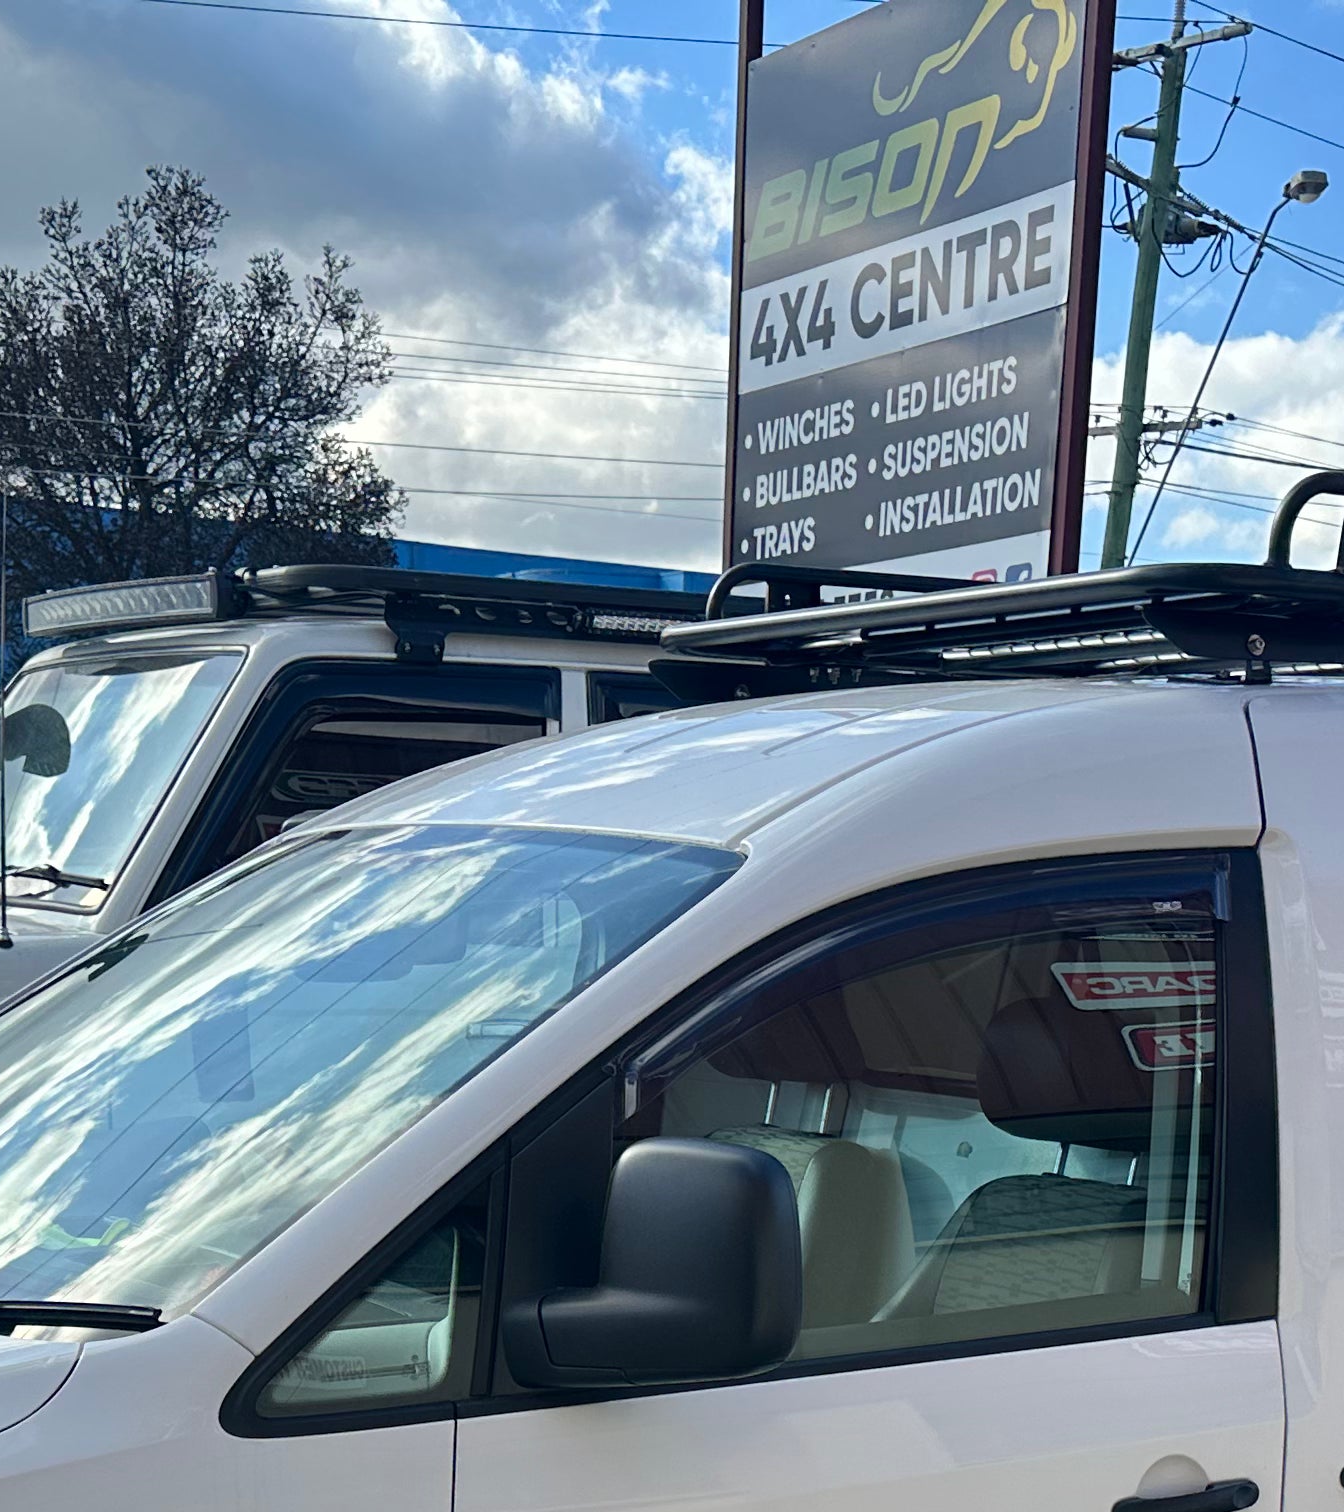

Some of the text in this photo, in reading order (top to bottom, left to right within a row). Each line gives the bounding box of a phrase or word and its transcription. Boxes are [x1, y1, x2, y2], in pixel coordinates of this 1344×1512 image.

[747, 94, 1001, 263] BISON
[749, 203, 1056, 367] 4X4 CENTRE
[885, 356, 1017, 424] LED LIGHTS
[758, 400, 854, 454] WINCHES
[882, 411, 1030, 481] SUSPENSION
[755, 453, 858, 509] BULLBARS
[878, 468, 1042, 537] INSTALLATION
[753, 516, 816, 560] TRAYS
